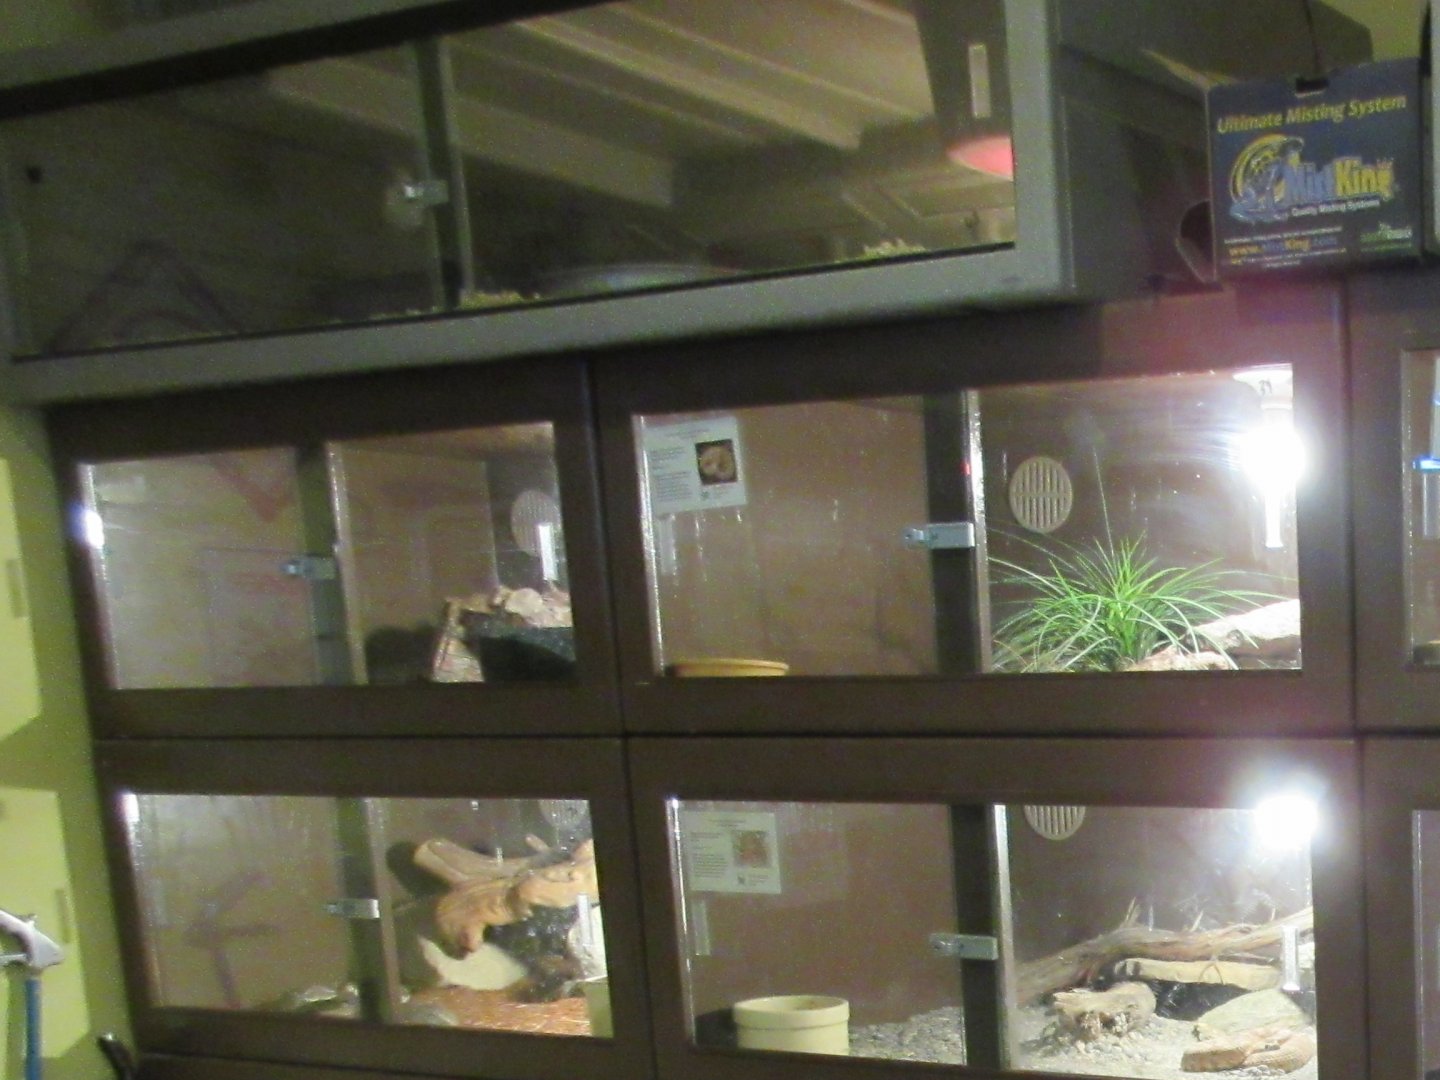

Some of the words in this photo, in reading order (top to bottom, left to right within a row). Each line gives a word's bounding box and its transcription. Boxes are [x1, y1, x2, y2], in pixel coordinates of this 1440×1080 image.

[1217, 113, 1283, 134] Ultimate
[1285, 102, 1347, 124] Misting
[1348, 95, 1407, 119] System
